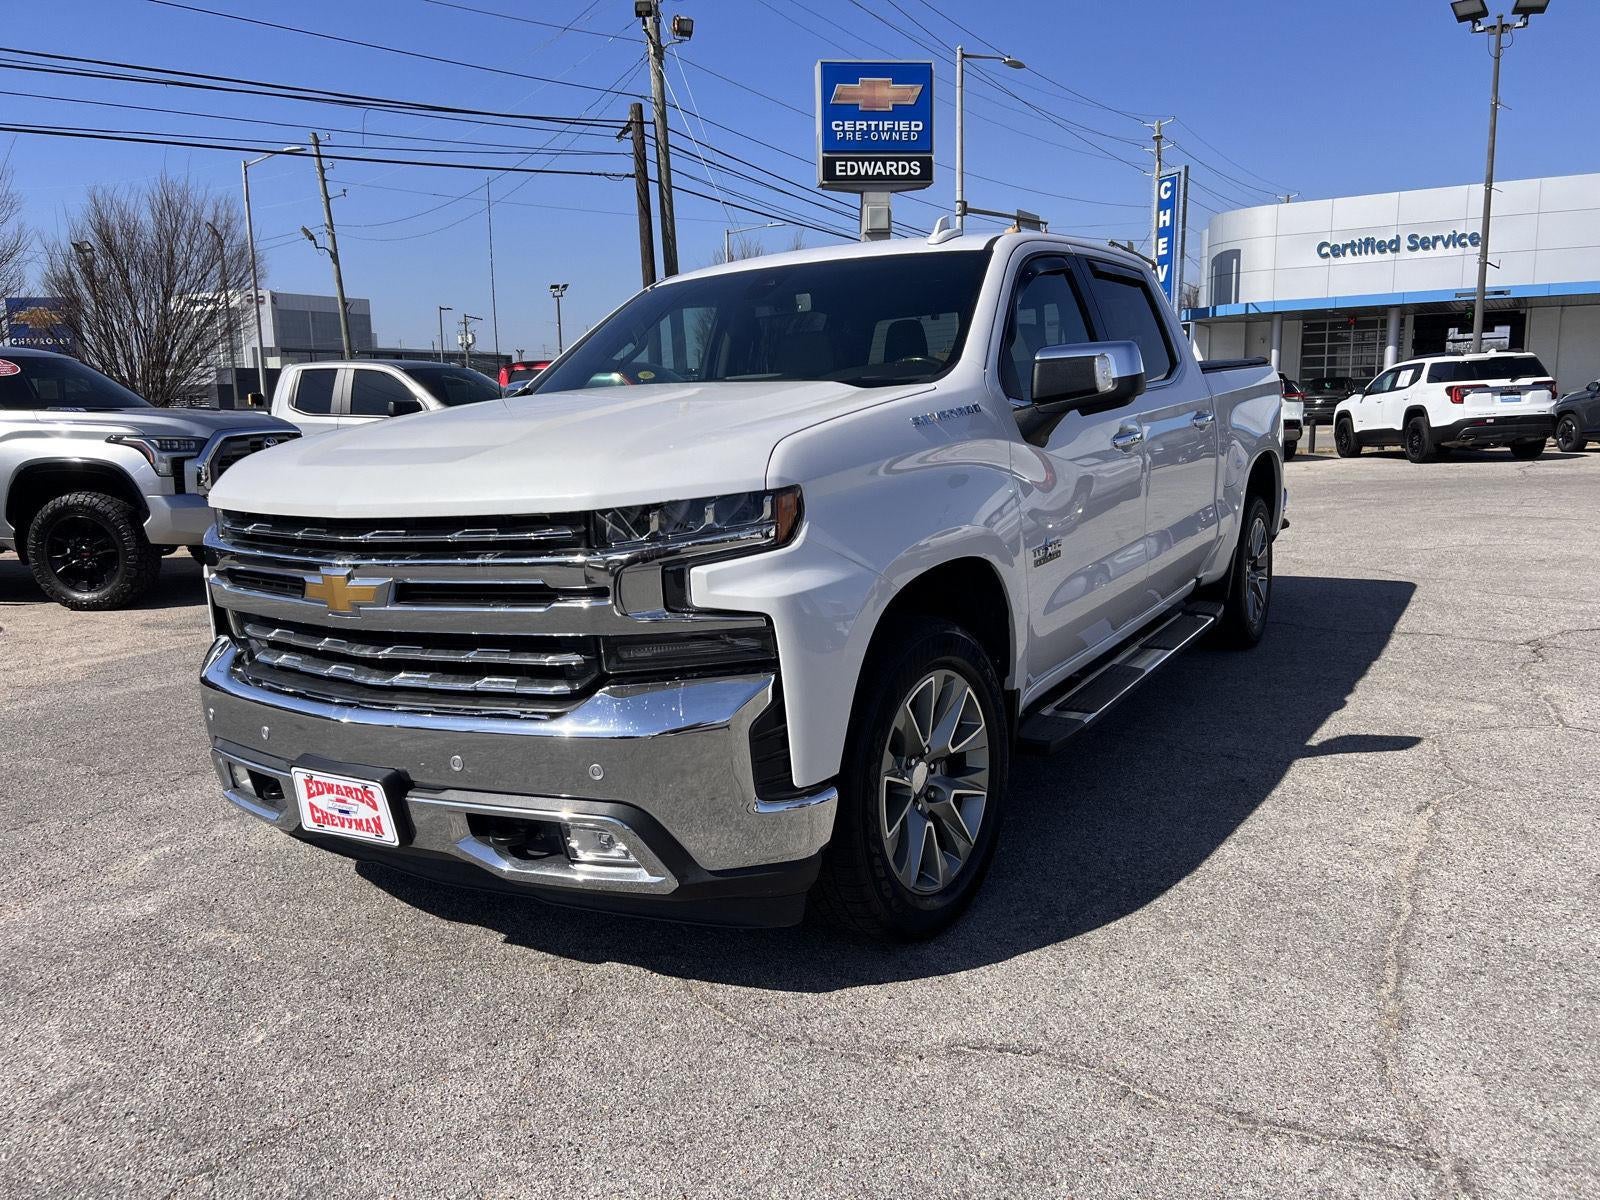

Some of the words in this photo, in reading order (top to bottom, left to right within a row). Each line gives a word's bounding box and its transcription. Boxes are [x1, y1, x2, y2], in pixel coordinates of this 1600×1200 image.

[831, 120, 923, 131] CERTIFIED
[836, 131, 918, 141] PRE-OWNED
[835, 161, 921, 176] EDWARDS
[1316, 234, 1401, 260] Certified
[1406, 229, 1482, 252] Service
[303, 778, 379, 812] EDWARDS
[308, 801, 385, 836] CHEVYMAN
